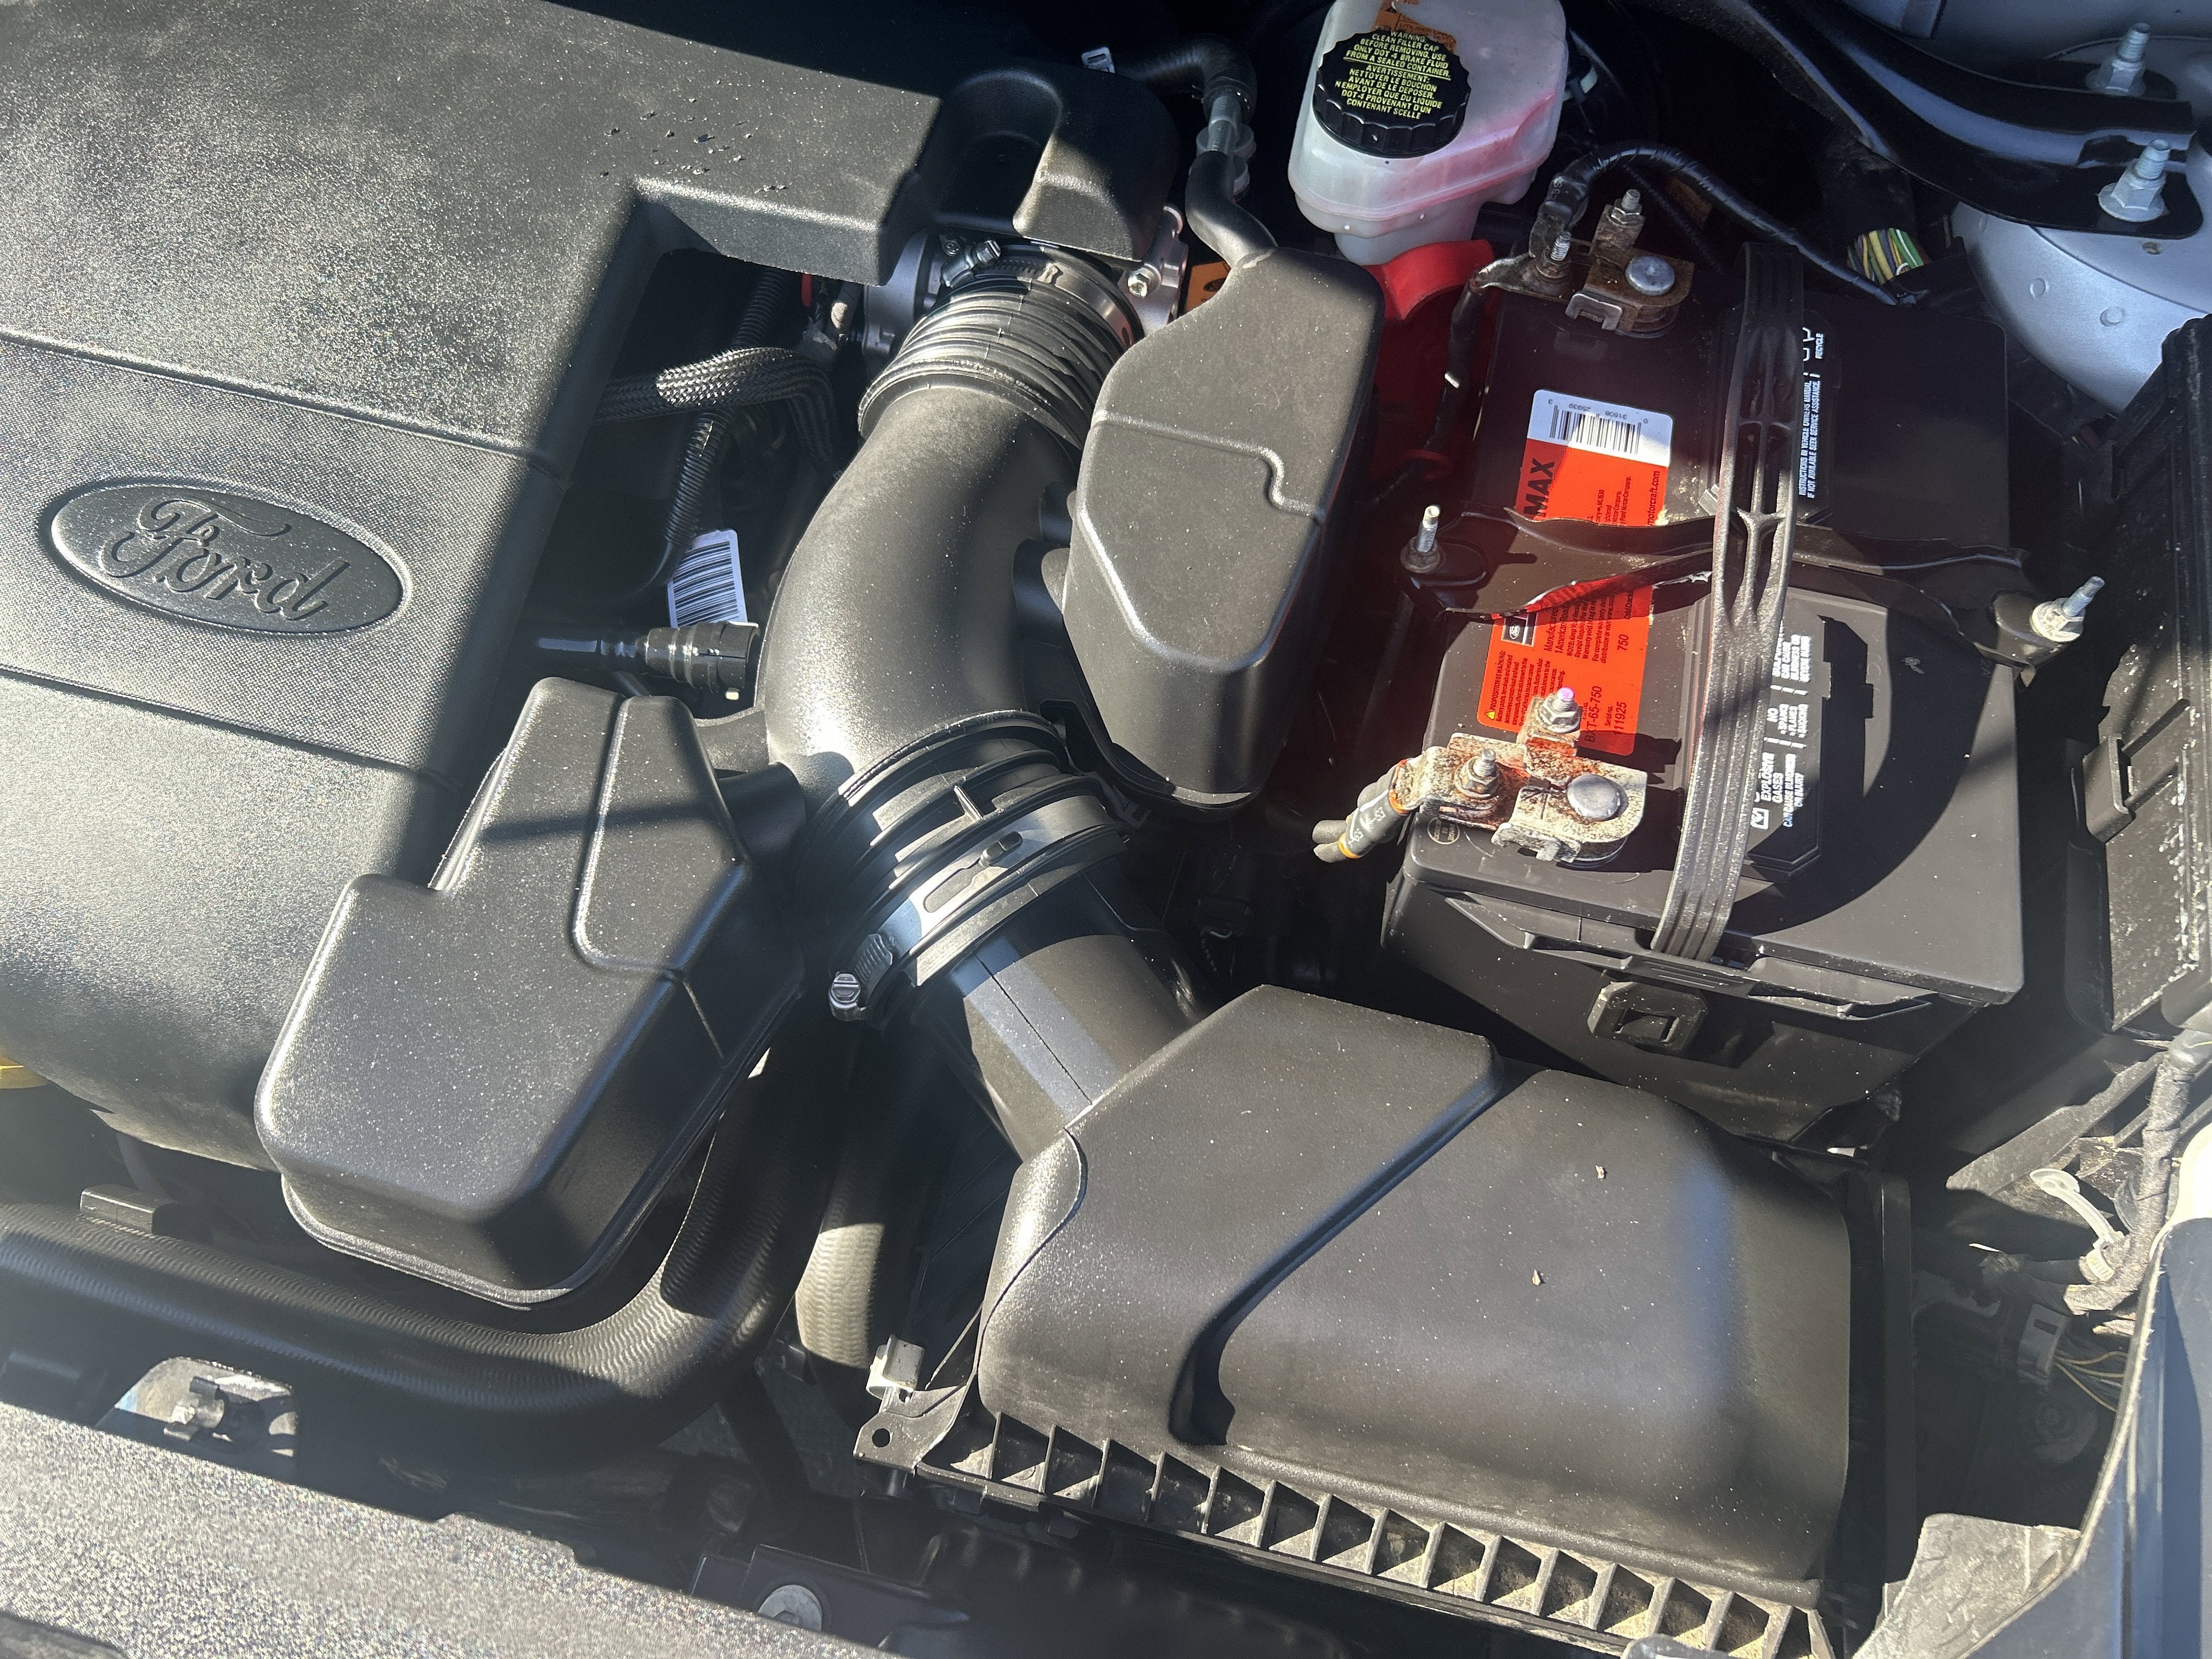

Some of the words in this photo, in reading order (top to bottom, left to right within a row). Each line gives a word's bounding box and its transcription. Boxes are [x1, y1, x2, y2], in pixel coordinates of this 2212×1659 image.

[1361, 38, 1389, 50] BEFORE
[1431, 52, 1447, 61] USE
[1372, 33, 1396, 44] CLEAN
[1397, 38, 1422, 49] FILLER
[1424, 43, 1440, 52] CAP
[1346, 50, 1369, 60] FROM
[1376, 57, 1406, 68] SEALED
[1407, 63, 1451, 77] CONTAINER.
[1353, 44, 1373, 54] ONLY
[1374, 49, 1390, 58] DOT
[1400, 54, 1425, 65] BRAKE
[1426, 59, 1448, 69] FLUID
[1349, 68, 1389, 82] NETTOYER
[1401, 78, 1437, 92] BOUCHON
[1366, 65, 1430, 83] AVERTISSEMENT:
[1348, 76, 1374, 88] AVANT
[1399, 86, 1435, 99] DEPOSER.
[1347, 98, 1392, 112] CONTENANT
[1393, 108, 1421, 120] SCELLE
[1366, 93, 1412, 109] PROVENANT
[1384, 91, 1398, 99] QUE
[1400, 93, 1412, 102] DU
[1413, 96, 1442, 109] LIQUIDE
[1814, 332, 1824, 359] RECYCLE
[1809, 413, 1819, 436] SERVICE
[1801, 427, 1810, 448] VEHICLE
[1808, 436, 1817, 450] SEEK
[1798, 456, 1810, 495] INSTRUCTIONS
[1807, 451, 1816, 479] AVAILABLE
[1523, 458, 1554, 516] MAX
[1807, 479, 1815, 492] NOT
[99, 498, 349, 620] Ford
[1554, 622, 1567, 650] American
[1584, 625, 1593, 636] void
[1592, 629, 1603, 653] complete
[1566, 640, 1575, 656] NOTE:
[1574, 639, 1583, 658] Receipt
[1582, 636, 1592, 659] Warranty
[1599, 636, 1609, 663] distributor
[1617, 634, 1629, 651] 750
[1781, 641, 1792, 663] CAUSE
[1780, 663, 1790, 679] CAN
[1489, 679, 1500, 710] PROPOSITION
[1496, 707, 1504, 722] Battery
[1500, 676, 1509, 695] terminals
[1515, 682, 1523, 702] chemicals
[1521, 692, 1530, 711] California
[1504, 701, 1513, 724] accessories
[1584, 686, 1602, 742] BXT-65-750
[1604, 713, 1612, 726] Serial
[1613, 702, 1627, 736] 111925
[1766, 707, 1778, 723] NO
[1787, 706, 1798, 732] FLAMES
[1797, 703, 1808, 733] SMOKING
[1759, 752, 1774, 801] EXPLOSIVE
[1771, 772, 1784, 803] GASES
[1794, 772, 1804, 797] INJURY
[1783, 789, 1793, 812] CAUSE
[1793, 797, 1803, 807] OR
[1782, 812, 1793, 827] CAN
